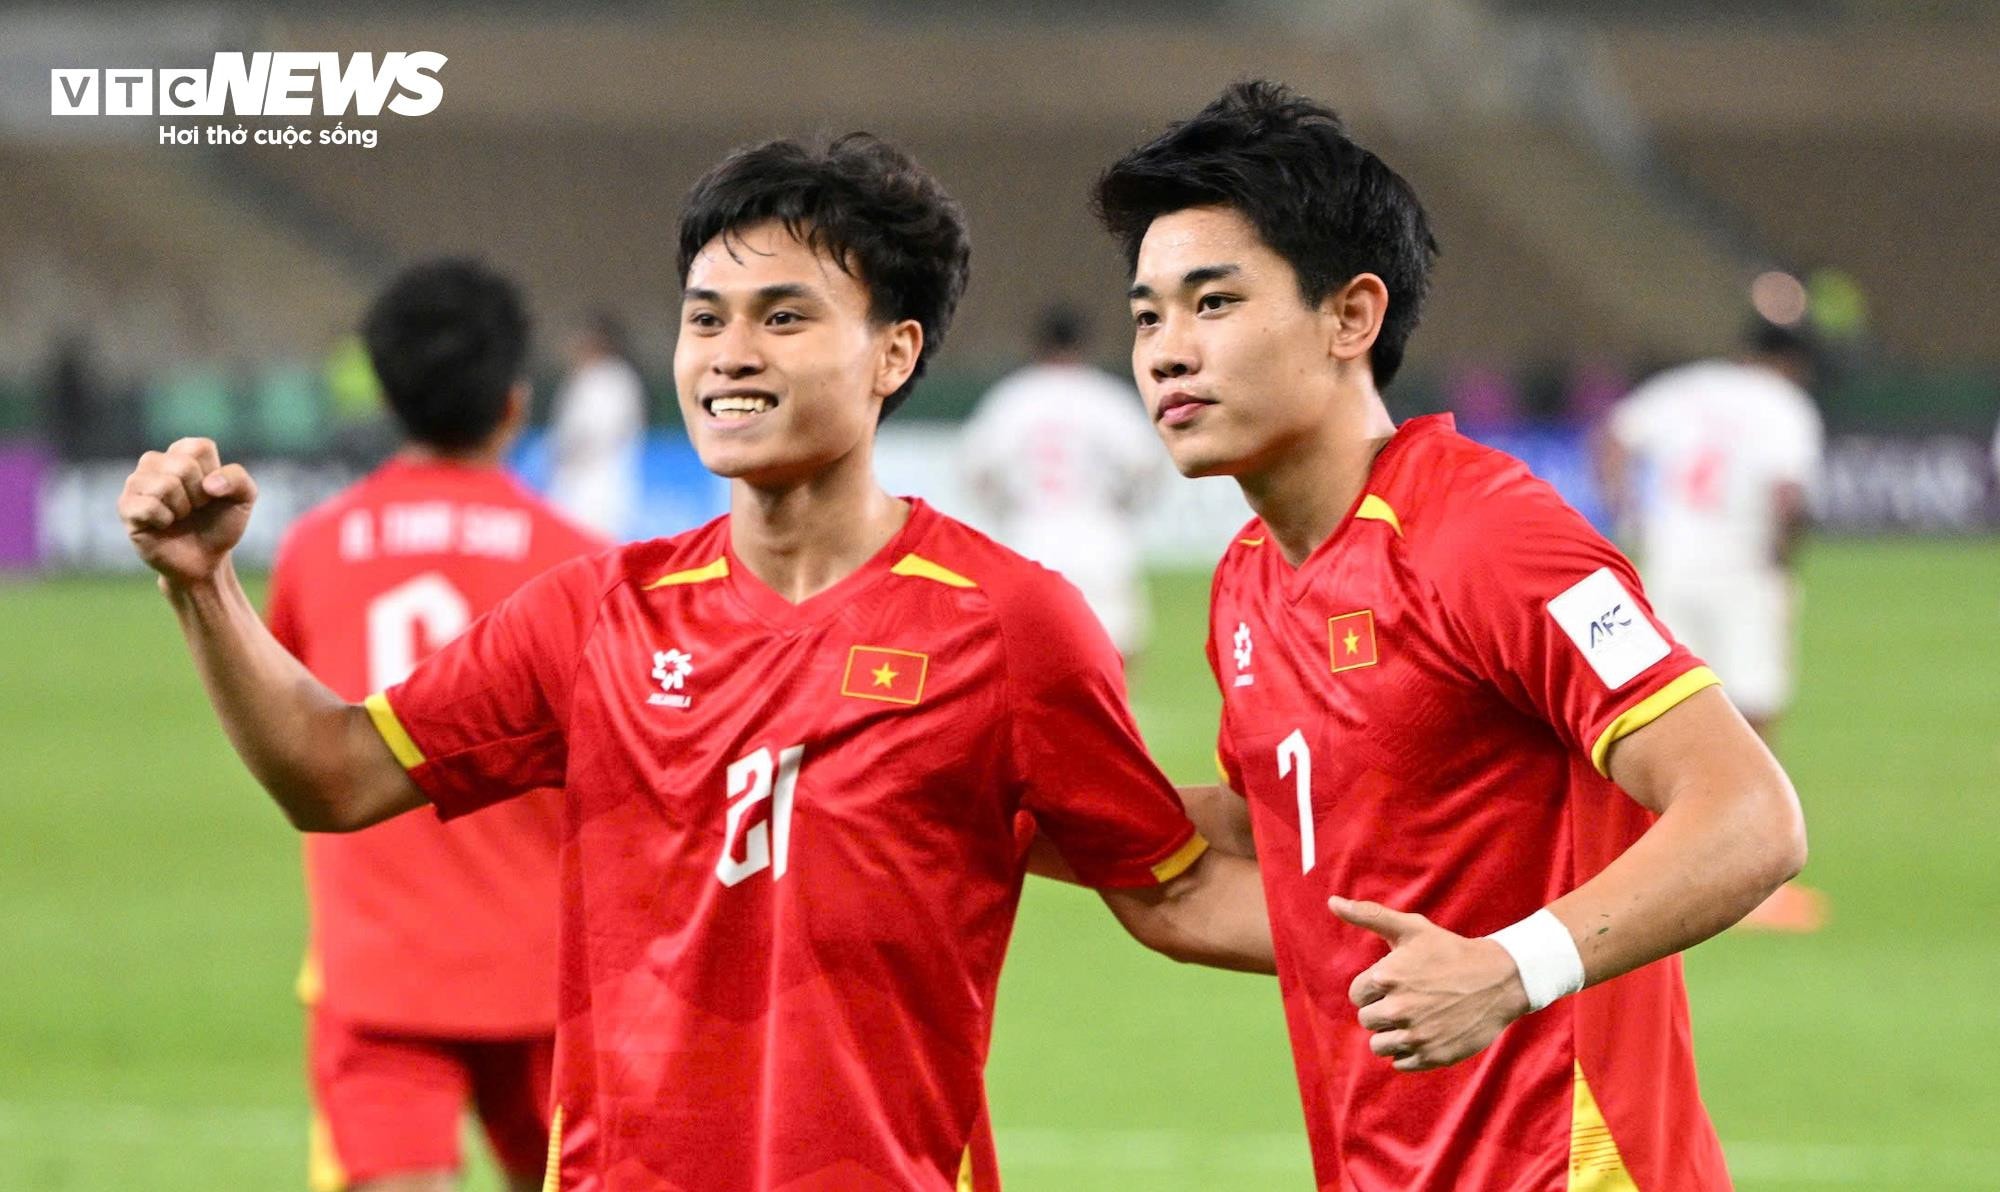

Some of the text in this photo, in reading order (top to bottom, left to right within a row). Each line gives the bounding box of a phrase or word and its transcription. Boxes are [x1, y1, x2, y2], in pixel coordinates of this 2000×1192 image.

[1590, 604, 1632, 649] AFC
[715, 743, 805, 888] 21
[1276, 728, 1316, 876] 7
